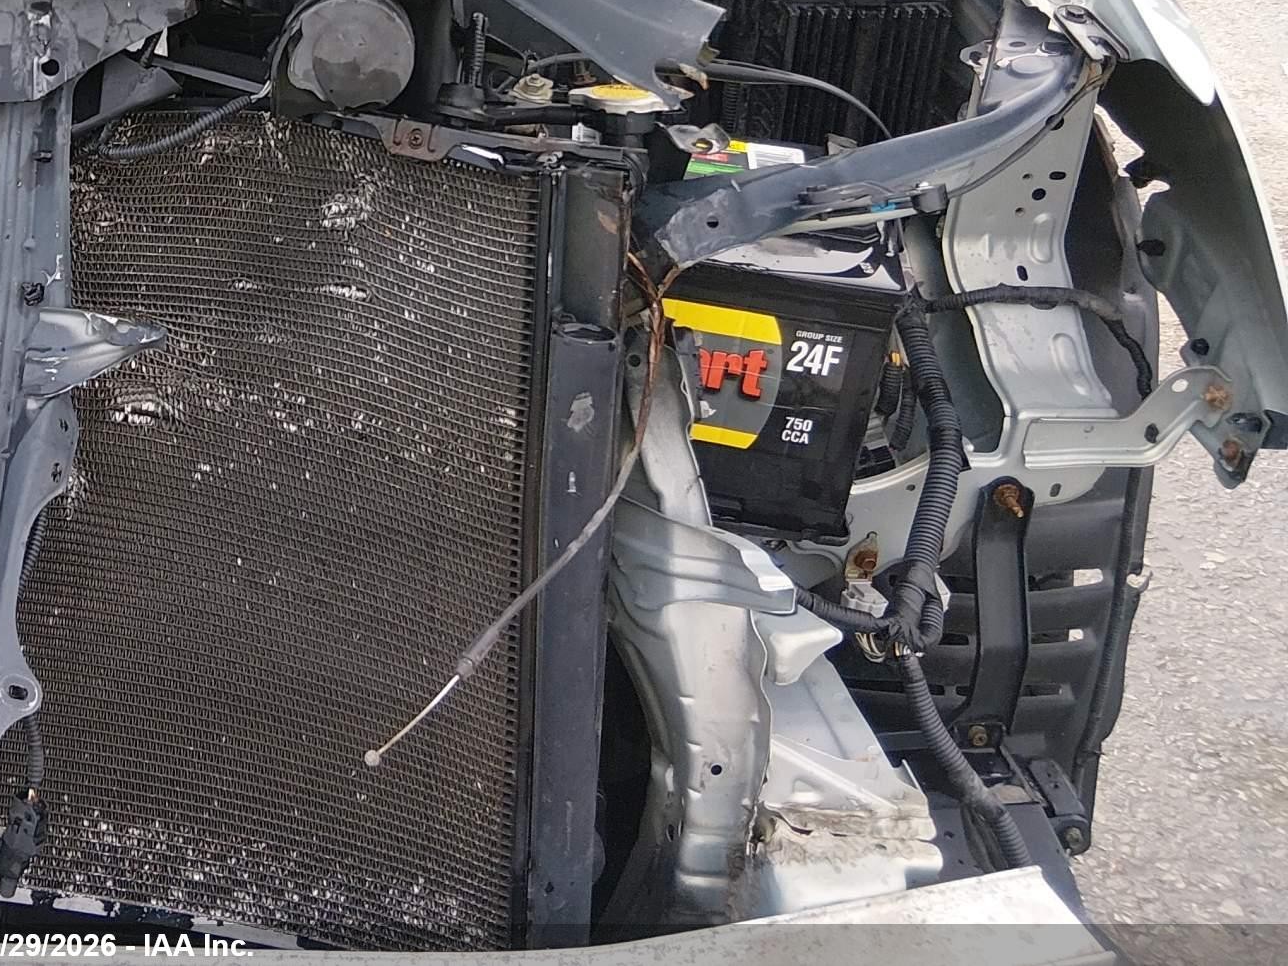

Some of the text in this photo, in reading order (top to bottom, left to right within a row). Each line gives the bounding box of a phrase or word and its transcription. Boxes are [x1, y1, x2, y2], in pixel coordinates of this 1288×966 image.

[796, 330, 843, 343] GROUP SIZE
[786, 340, 843, 376] 24F
[785, 416, 813, 432] 750
[781, 430, 809, 444] CCA
